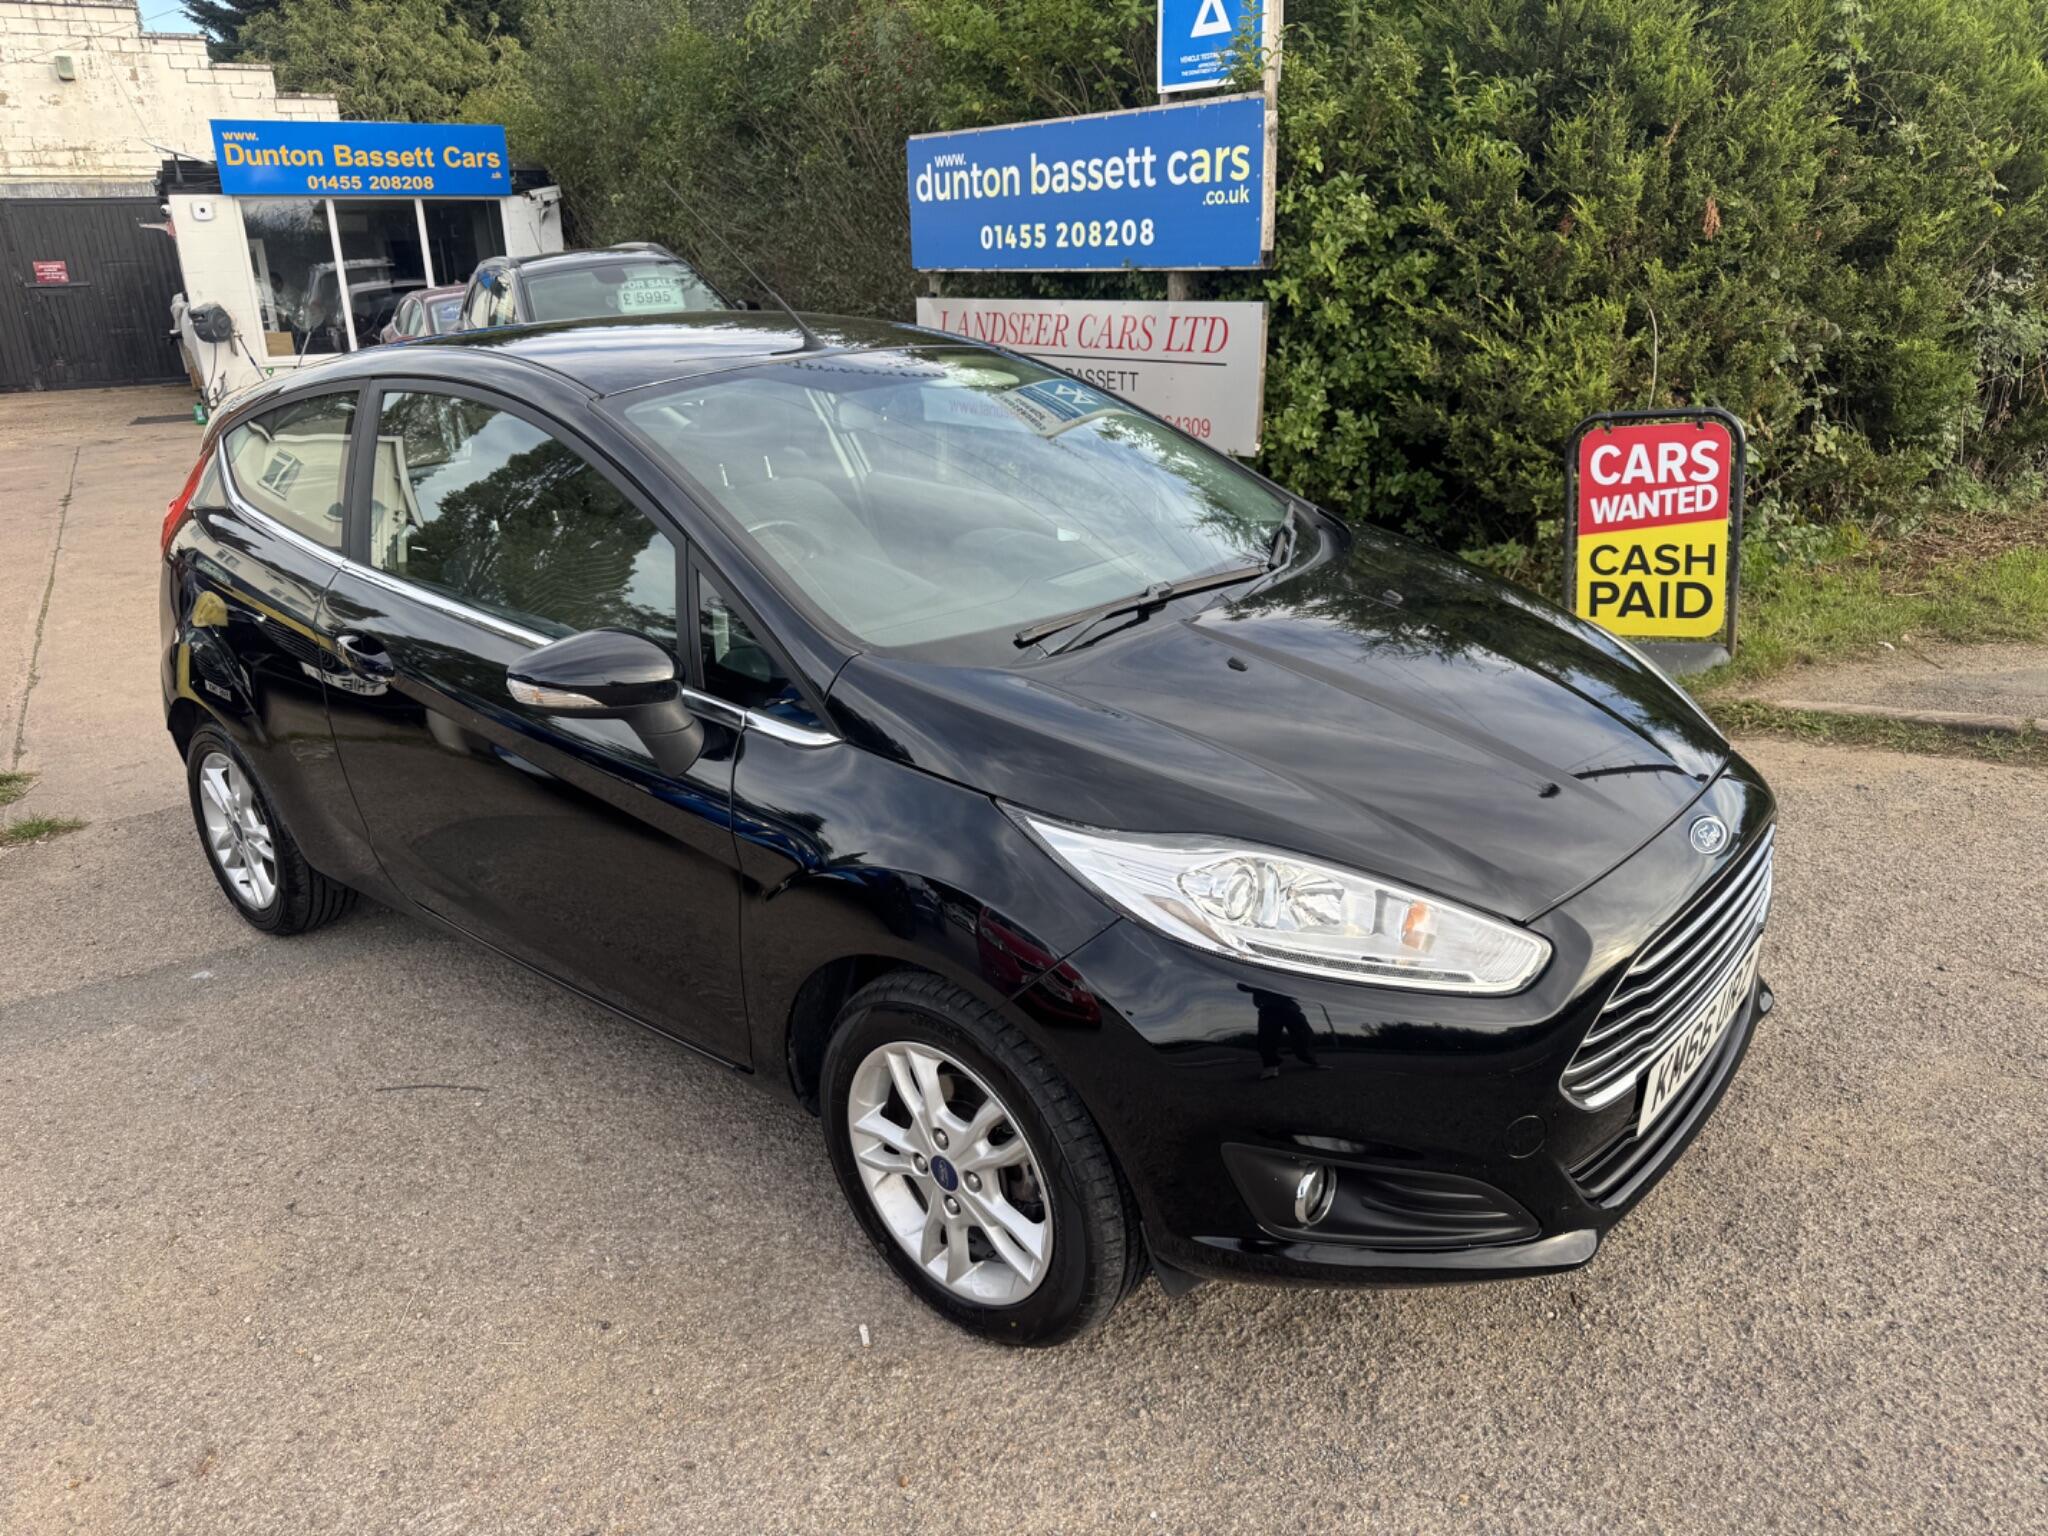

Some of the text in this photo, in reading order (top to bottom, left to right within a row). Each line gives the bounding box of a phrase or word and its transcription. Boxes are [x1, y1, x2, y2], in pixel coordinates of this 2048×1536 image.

[222, 131, 259, 141] www.
[223, 143, 501, 168] Dunton Bassett Cars
[934, 153, 967, 168] www.
[307, 175, 435, 190] 01455 208208
[916, 145, 1250, 202] dunton bassett cars
[1202, 184, 1250, 206] .co.uk
[980, 218, 1155, 250] 01455 208208
[940, 310, 1229, 353] LANDSEER CARS LTD
[1590, 440, 1720, 485] CARS
[1590, 484, 1719, 524] WANTED
[1590, 544, 1716, 576] CASH
[1589, 581, 1713, 619] PAID
[1651, 1005, 1718, 1112] KM66
